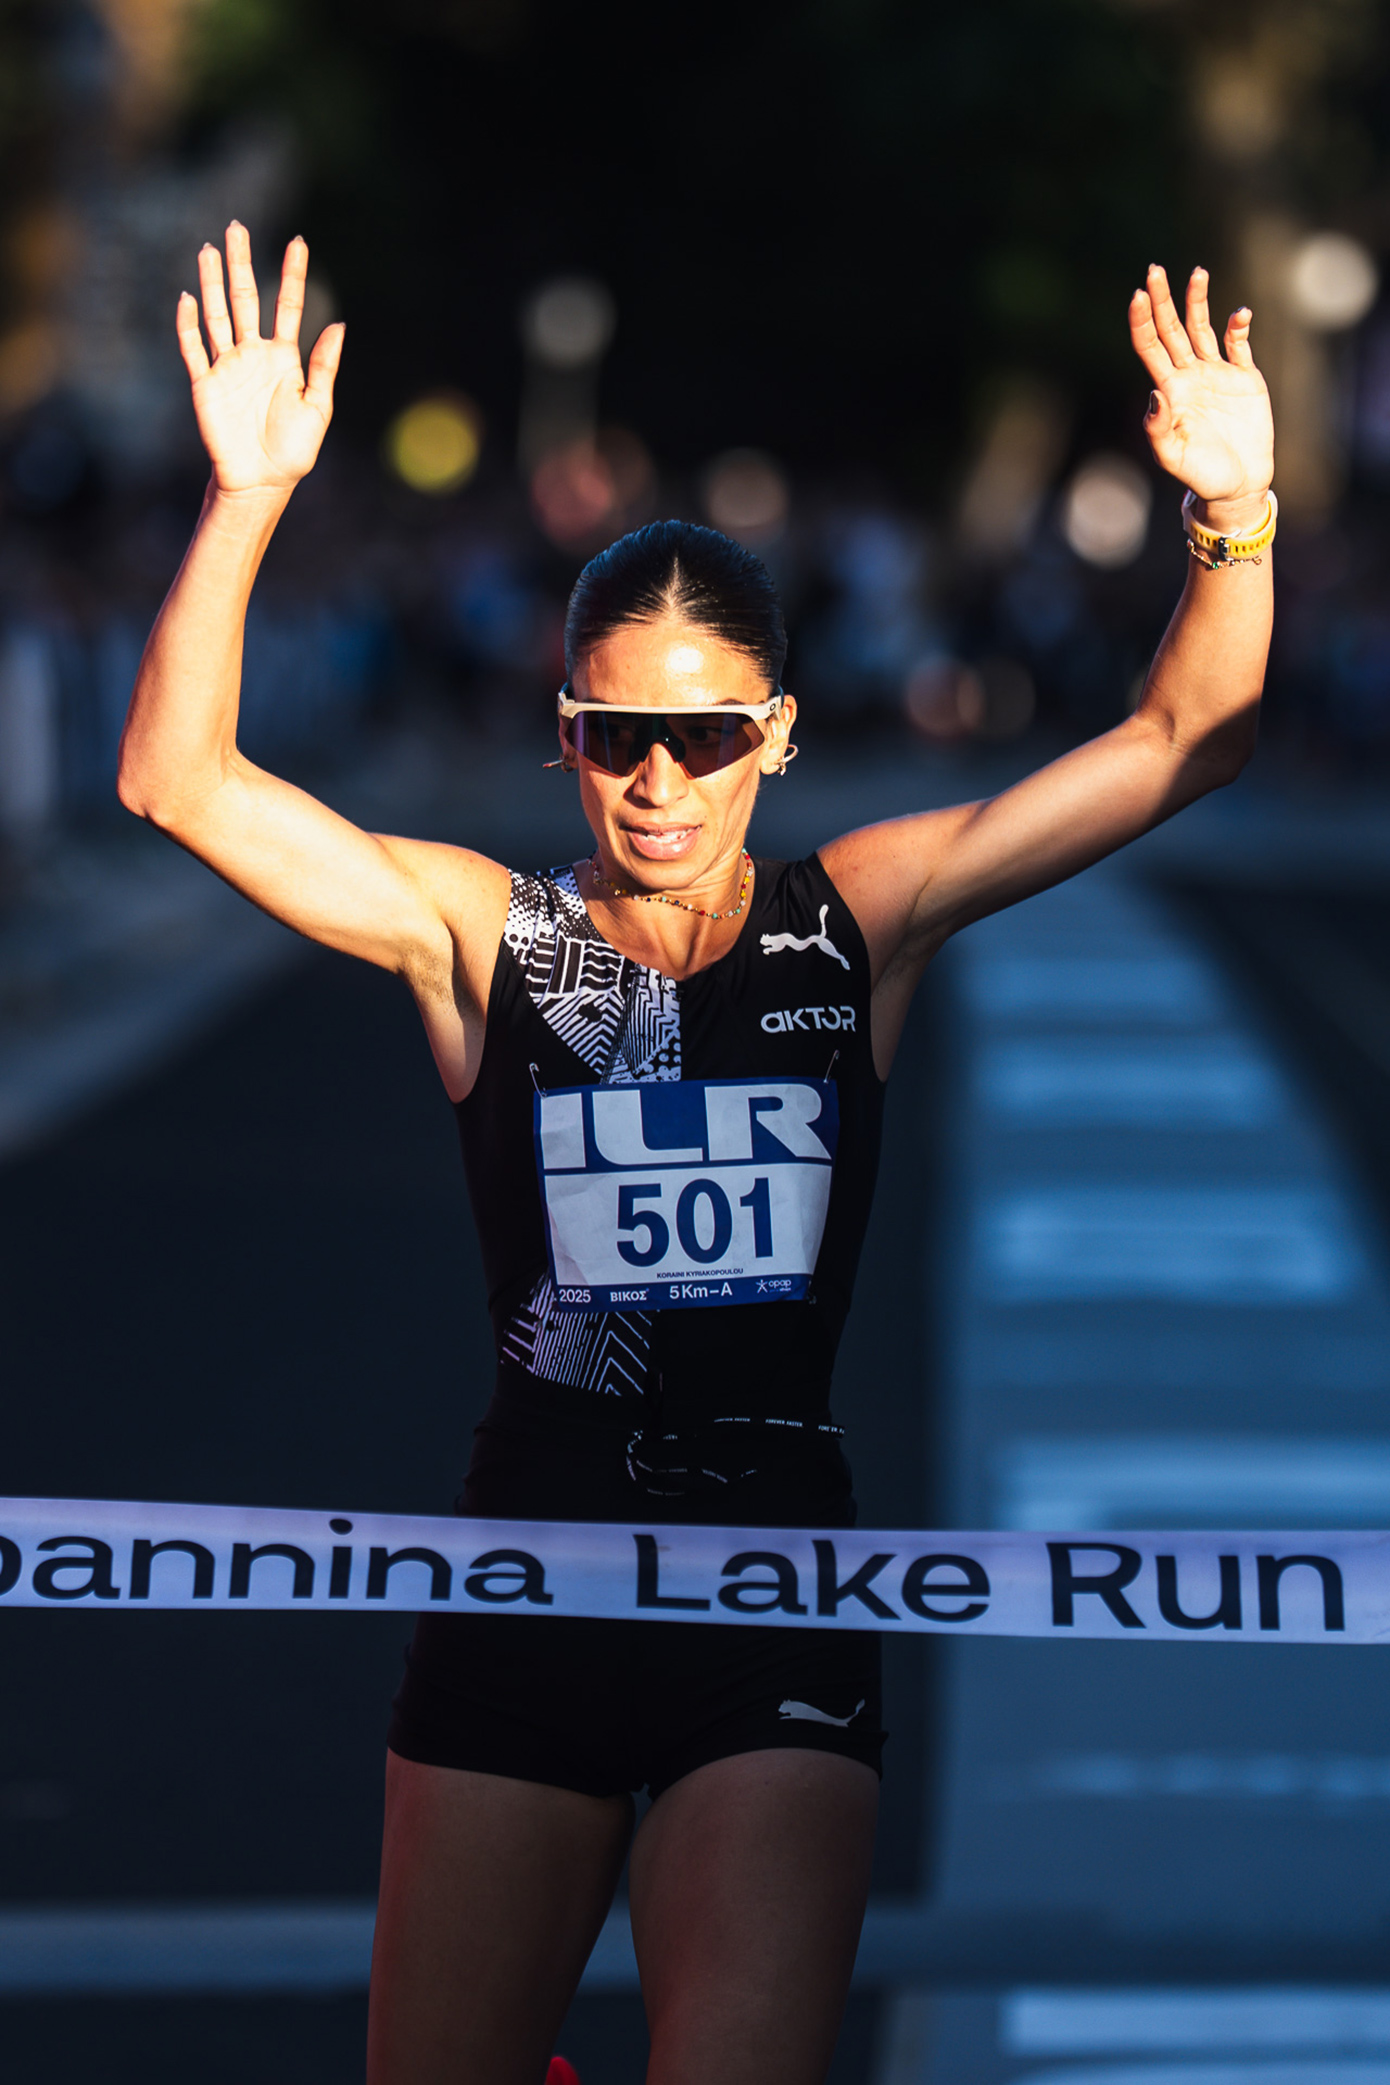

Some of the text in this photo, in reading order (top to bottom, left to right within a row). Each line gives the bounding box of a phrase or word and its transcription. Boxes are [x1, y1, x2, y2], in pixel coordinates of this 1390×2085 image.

[540, 1083, 832, 1170] ILR
[616, 1177, 774, 1268] 501
[656, 1268, 744, 1279] KORAINI KYRIAKOPOULOU
[768, 1279, 792, 1289] opap
[559, 1288, 592, 1303] 2025
[610, 1290, 647, 1302] ΒΙΚΟΣ
[786, 1420, 803, 1428] FASTER
[0, 1518, 1346, 1632] annina Lake Run
